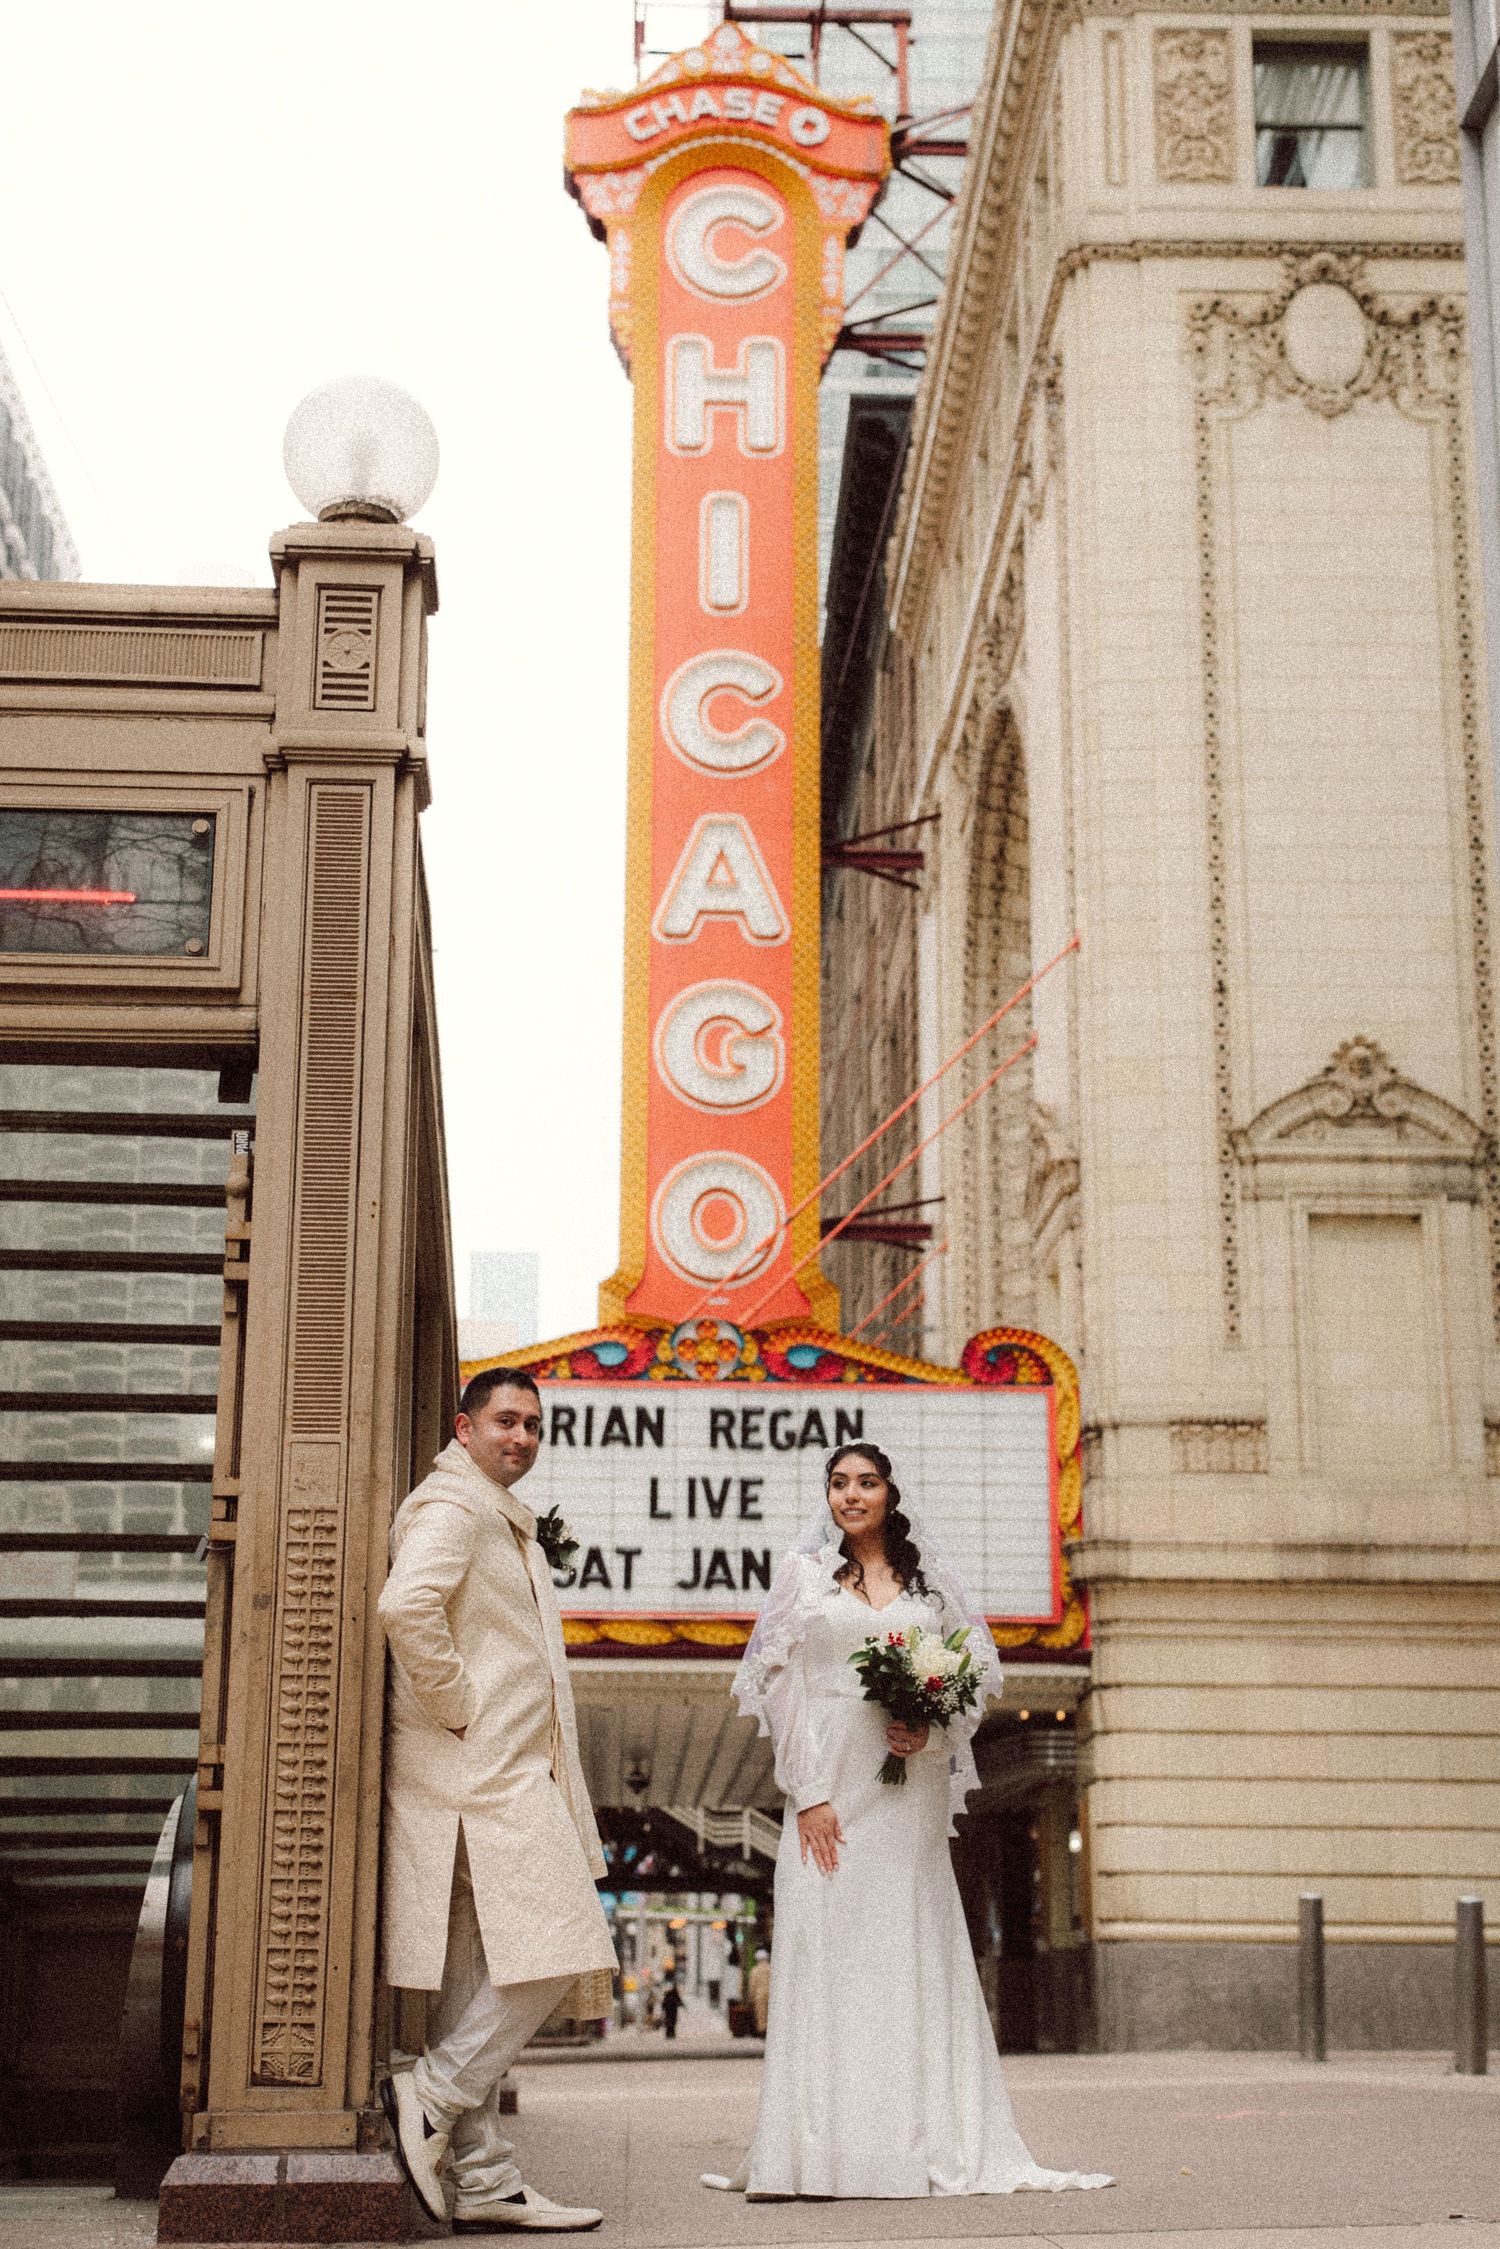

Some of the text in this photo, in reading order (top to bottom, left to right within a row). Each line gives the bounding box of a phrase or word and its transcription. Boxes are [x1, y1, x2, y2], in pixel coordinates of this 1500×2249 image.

[625, 89, 784, 142] CHASE
[651, 184, 790, 1289] CHICAGO
[540, 1404, 864, 1450] RIAN REGAN
[649, 1477, 764, 1520] LIVE
[676, 1548, 771, 1590] JAN
